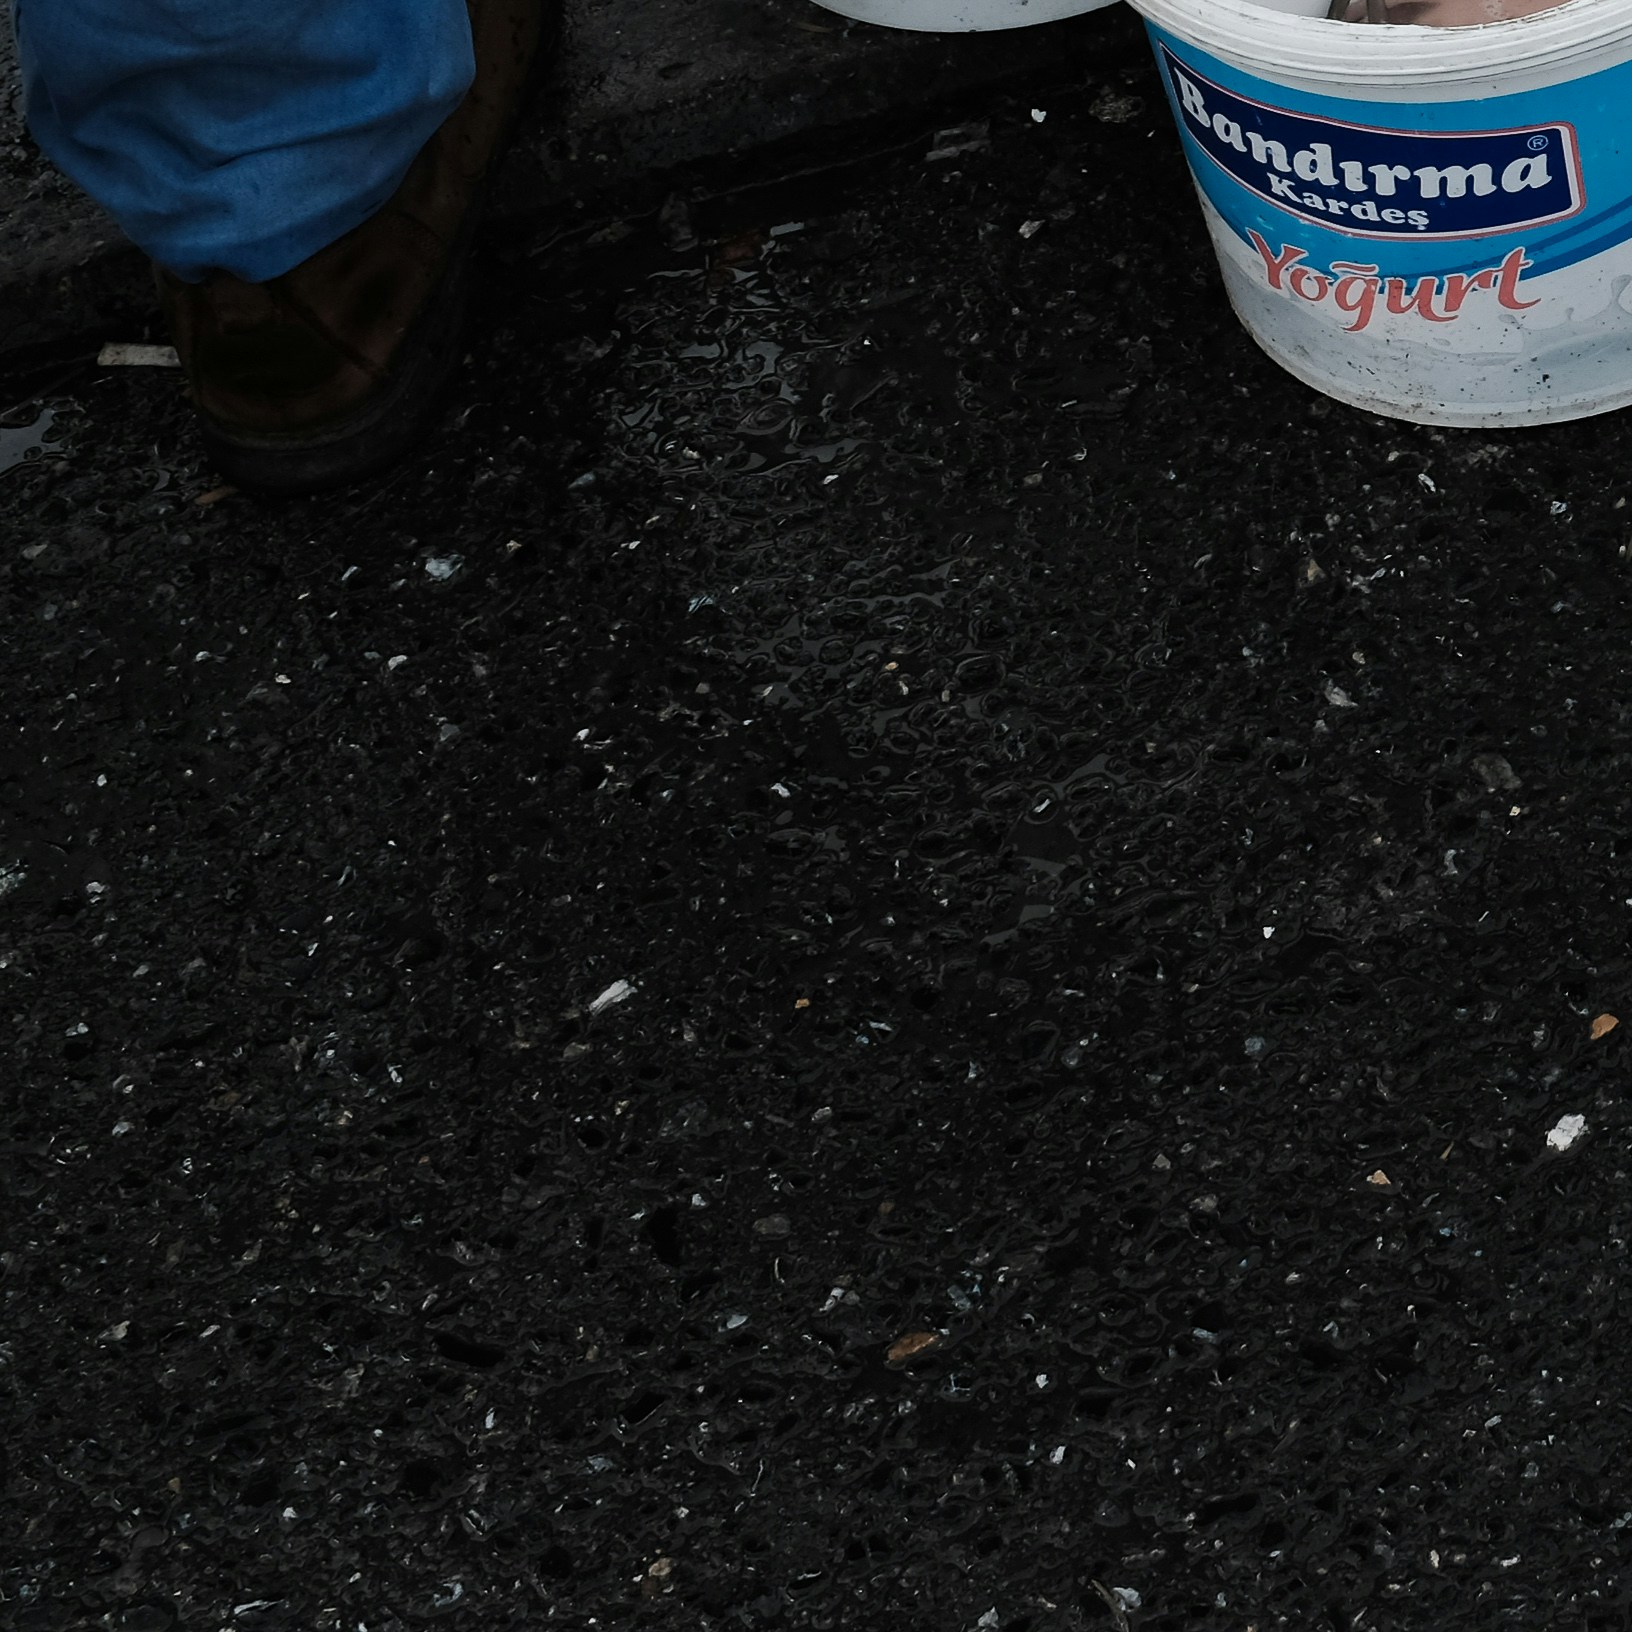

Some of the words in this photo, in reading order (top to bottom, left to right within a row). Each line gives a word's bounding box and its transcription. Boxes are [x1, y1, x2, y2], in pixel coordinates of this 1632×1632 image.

[1174, 66, 1553, 200] Bandırma
[1266, 171, 1431, 231] Kardeş
[1246, 227, 1542, 333] Yoğurt
